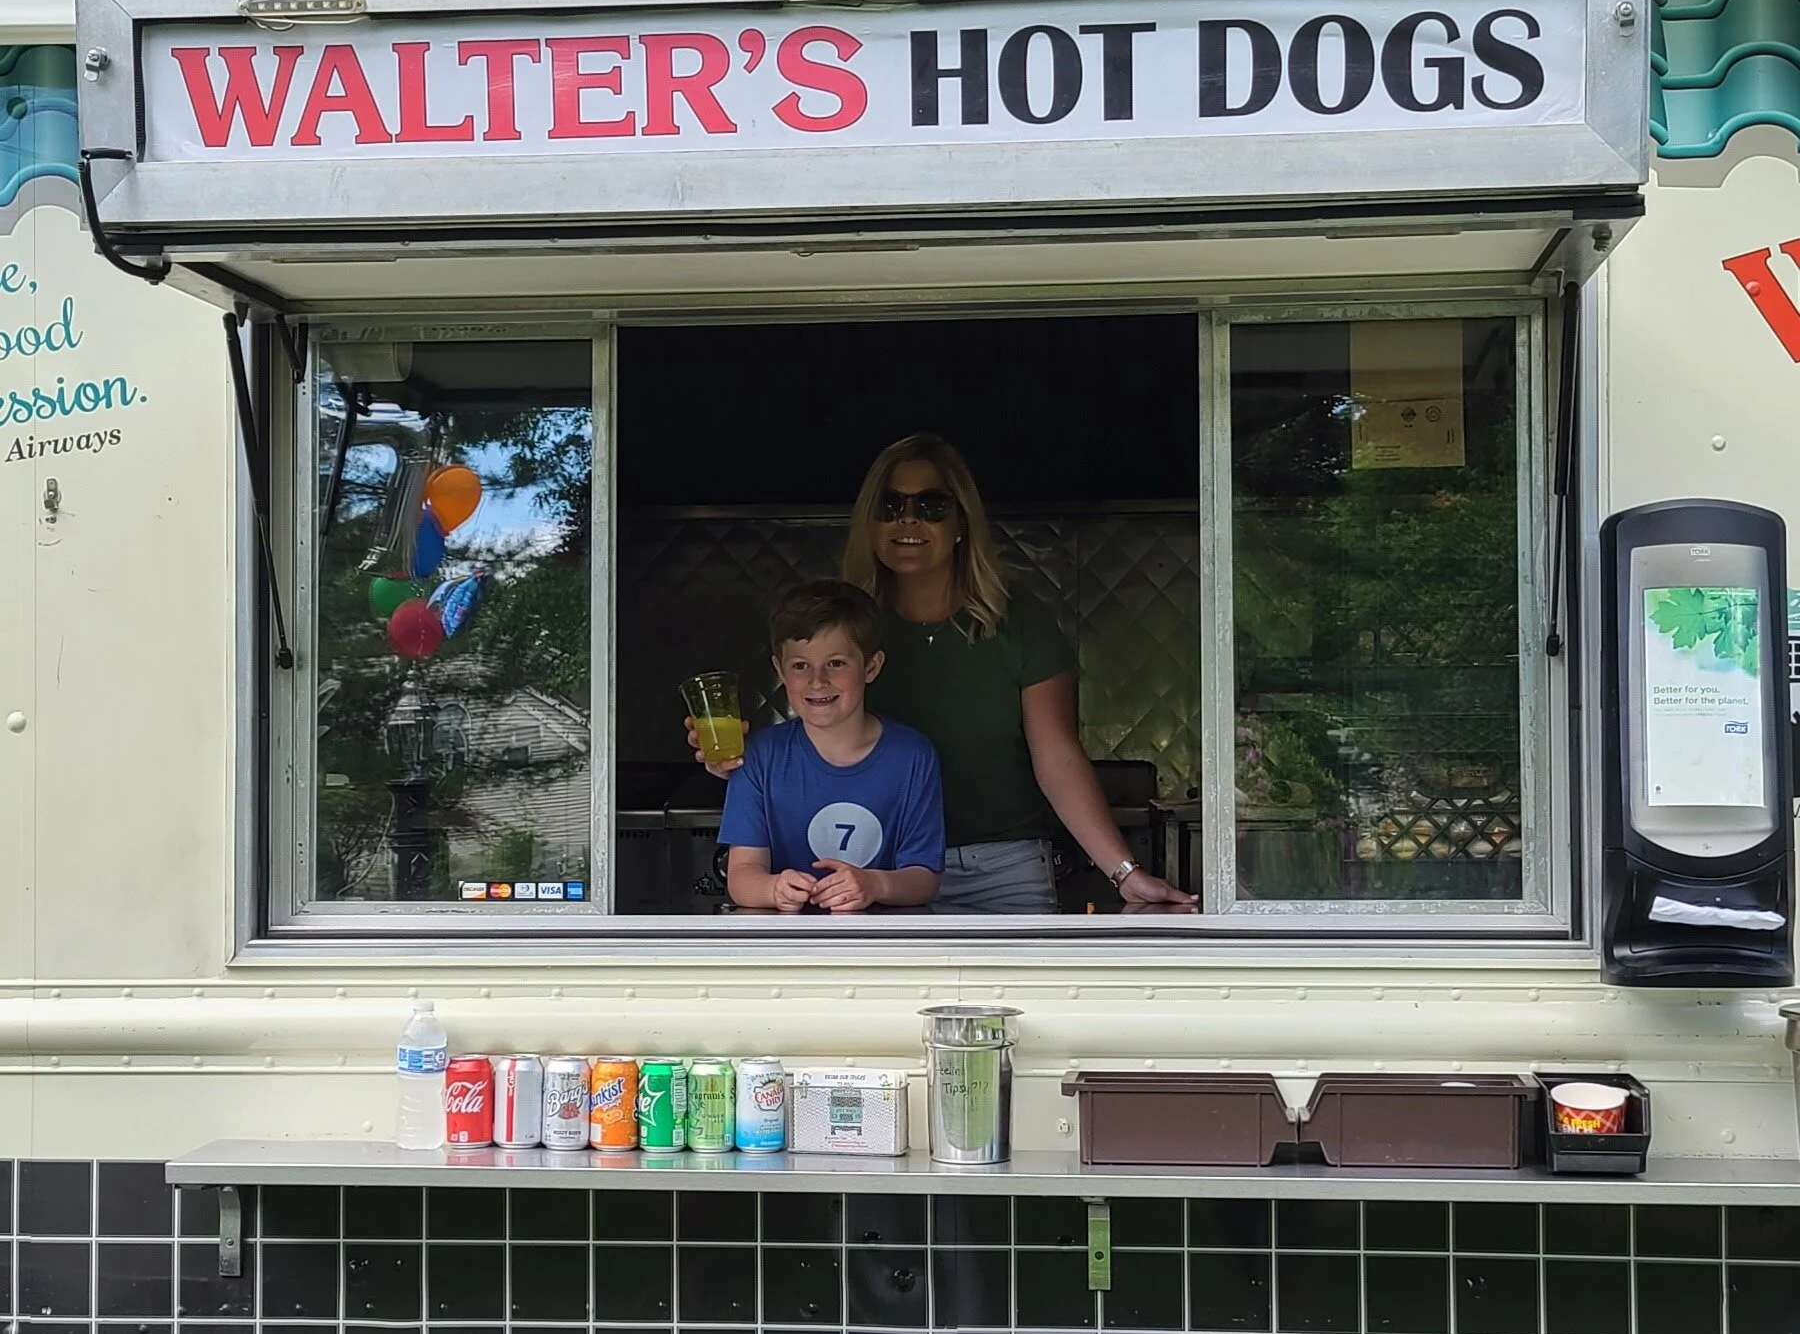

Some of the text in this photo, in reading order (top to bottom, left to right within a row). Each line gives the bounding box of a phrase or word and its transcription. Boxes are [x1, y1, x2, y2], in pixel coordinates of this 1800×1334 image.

[171, 9, 1545, 148] WALTER'S HOT DOGS
[0, 376, 148, 427] ssion.
[4, 427, 122, 463] Airways
[1653, 686, 1720, 696] Better for you.
[1653, 697, 1682, 705] Better
[1700, 697, 1715, 705] the
[1718, 697, 1749, 706] planet.
[1725, 723, 1748, 734] TORK
[835, 823, 856, 851] 7
[541, 885, 562, 895] VISA
[548, 1079, 588, 1117] Barq's
